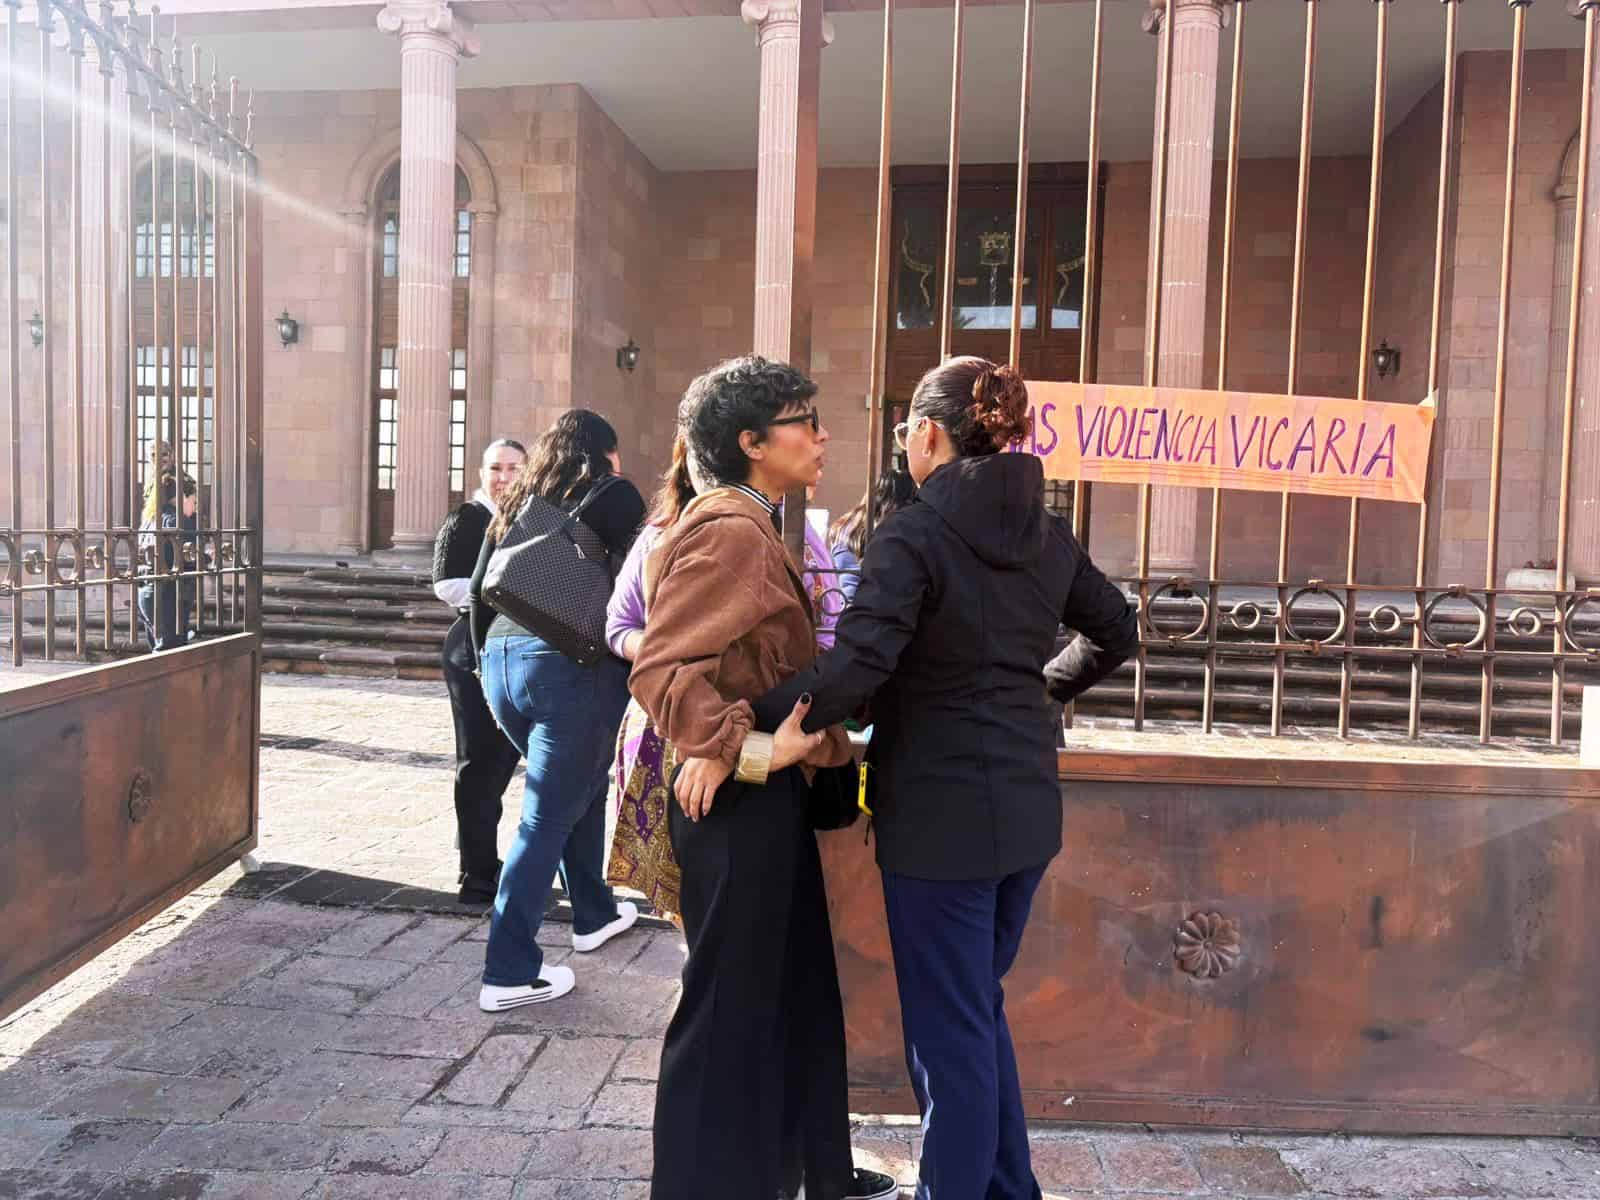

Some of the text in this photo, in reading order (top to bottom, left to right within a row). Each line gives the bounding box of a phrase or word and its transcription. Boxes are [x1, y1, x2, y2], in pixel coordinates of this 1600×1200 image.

[1009, 403, 1396, 478] AS VIOLENCIA VICARIA
